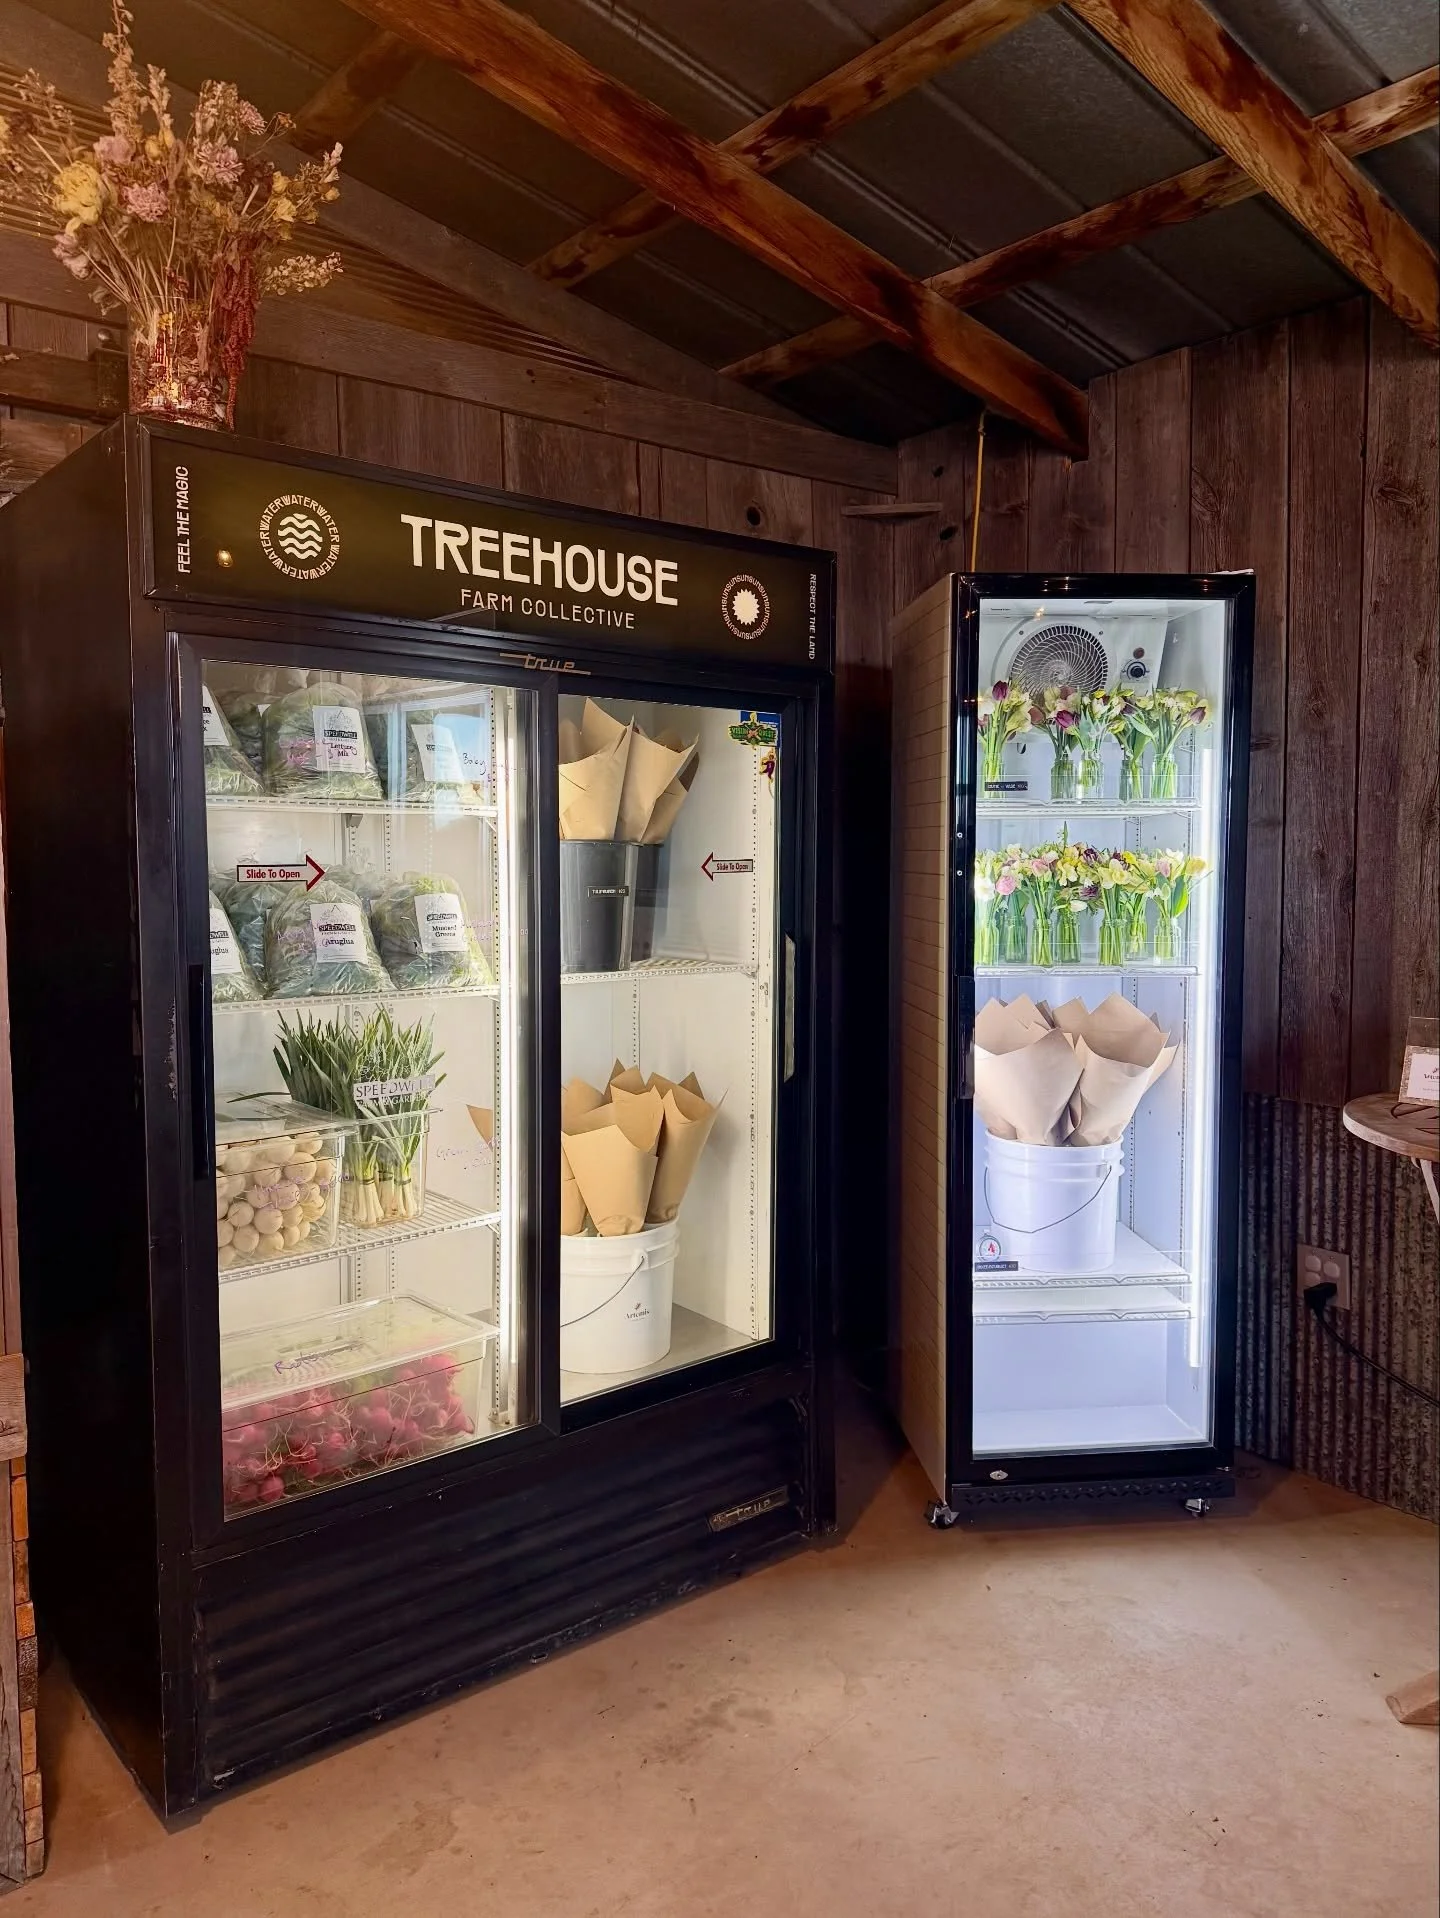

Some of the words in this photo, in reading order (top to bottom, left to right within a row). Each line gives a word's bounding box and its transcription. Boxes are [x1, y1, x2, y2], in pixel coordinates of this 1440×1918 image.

[175, 465, 189, 510] MAGIC
[176, 511, 190, 537] THE
[177, 538, 191, 574] FEEL
[400, 513, 678, 606] TREEHOUSE
[460, 588, 513, 613] FARM
[521, 597, 635, 629] COLLECTIVE
[809, 573, 817, 614] RESPECT
[808, 635, 816, 660] LAND
[246, 868, 267, 879] Slide
[268, 868, 277, 879] To
[279, 868, 301, 880] Open
[716, 862, 729, 871] Slide
[729, 862, 735, 870] To
[735, 862, 749, 870] Open
